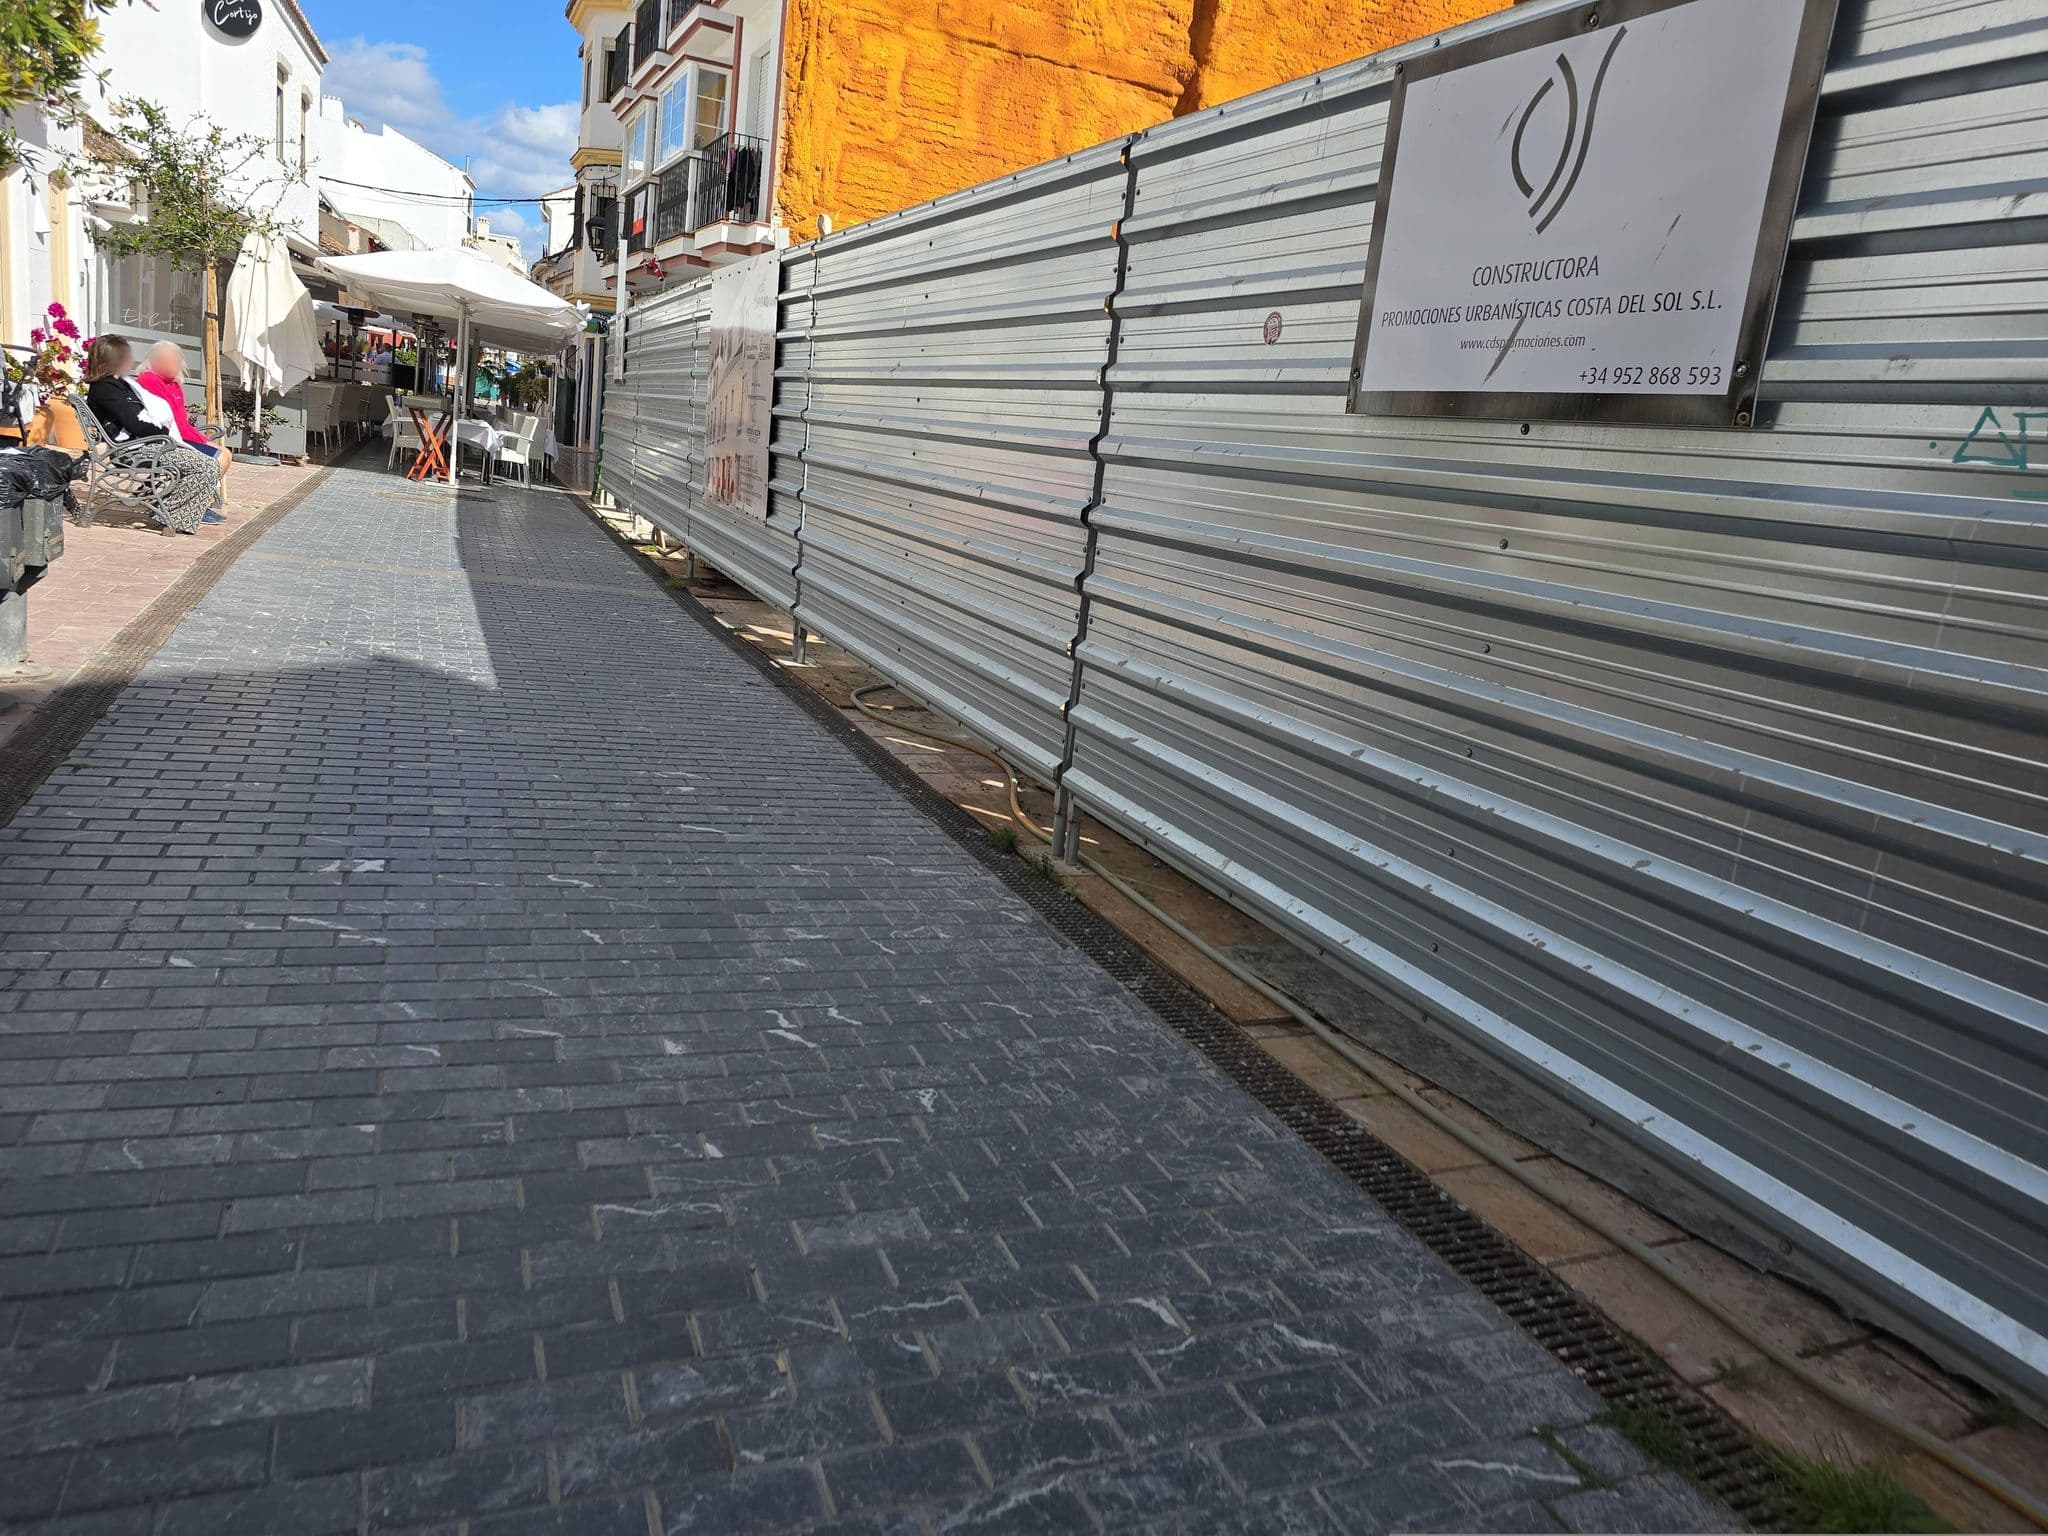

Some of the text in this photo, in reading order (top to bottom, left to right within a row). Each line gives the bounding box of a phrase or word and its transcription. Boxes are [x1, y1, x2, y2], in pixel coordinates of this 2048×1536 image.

[214, 0, 258, 26] Cortijo
[1472, 255, 1600, 287] CONSTRUCTORA
[1381, 290, 1722, 327] PROMOCIONES URBANÍSTICAS COSTA DEL SOL S.L.
[1460, 334, 1586, 352] www.cdspomociones.com
[1579, 366, 1722, 386] +34 952 868 593
